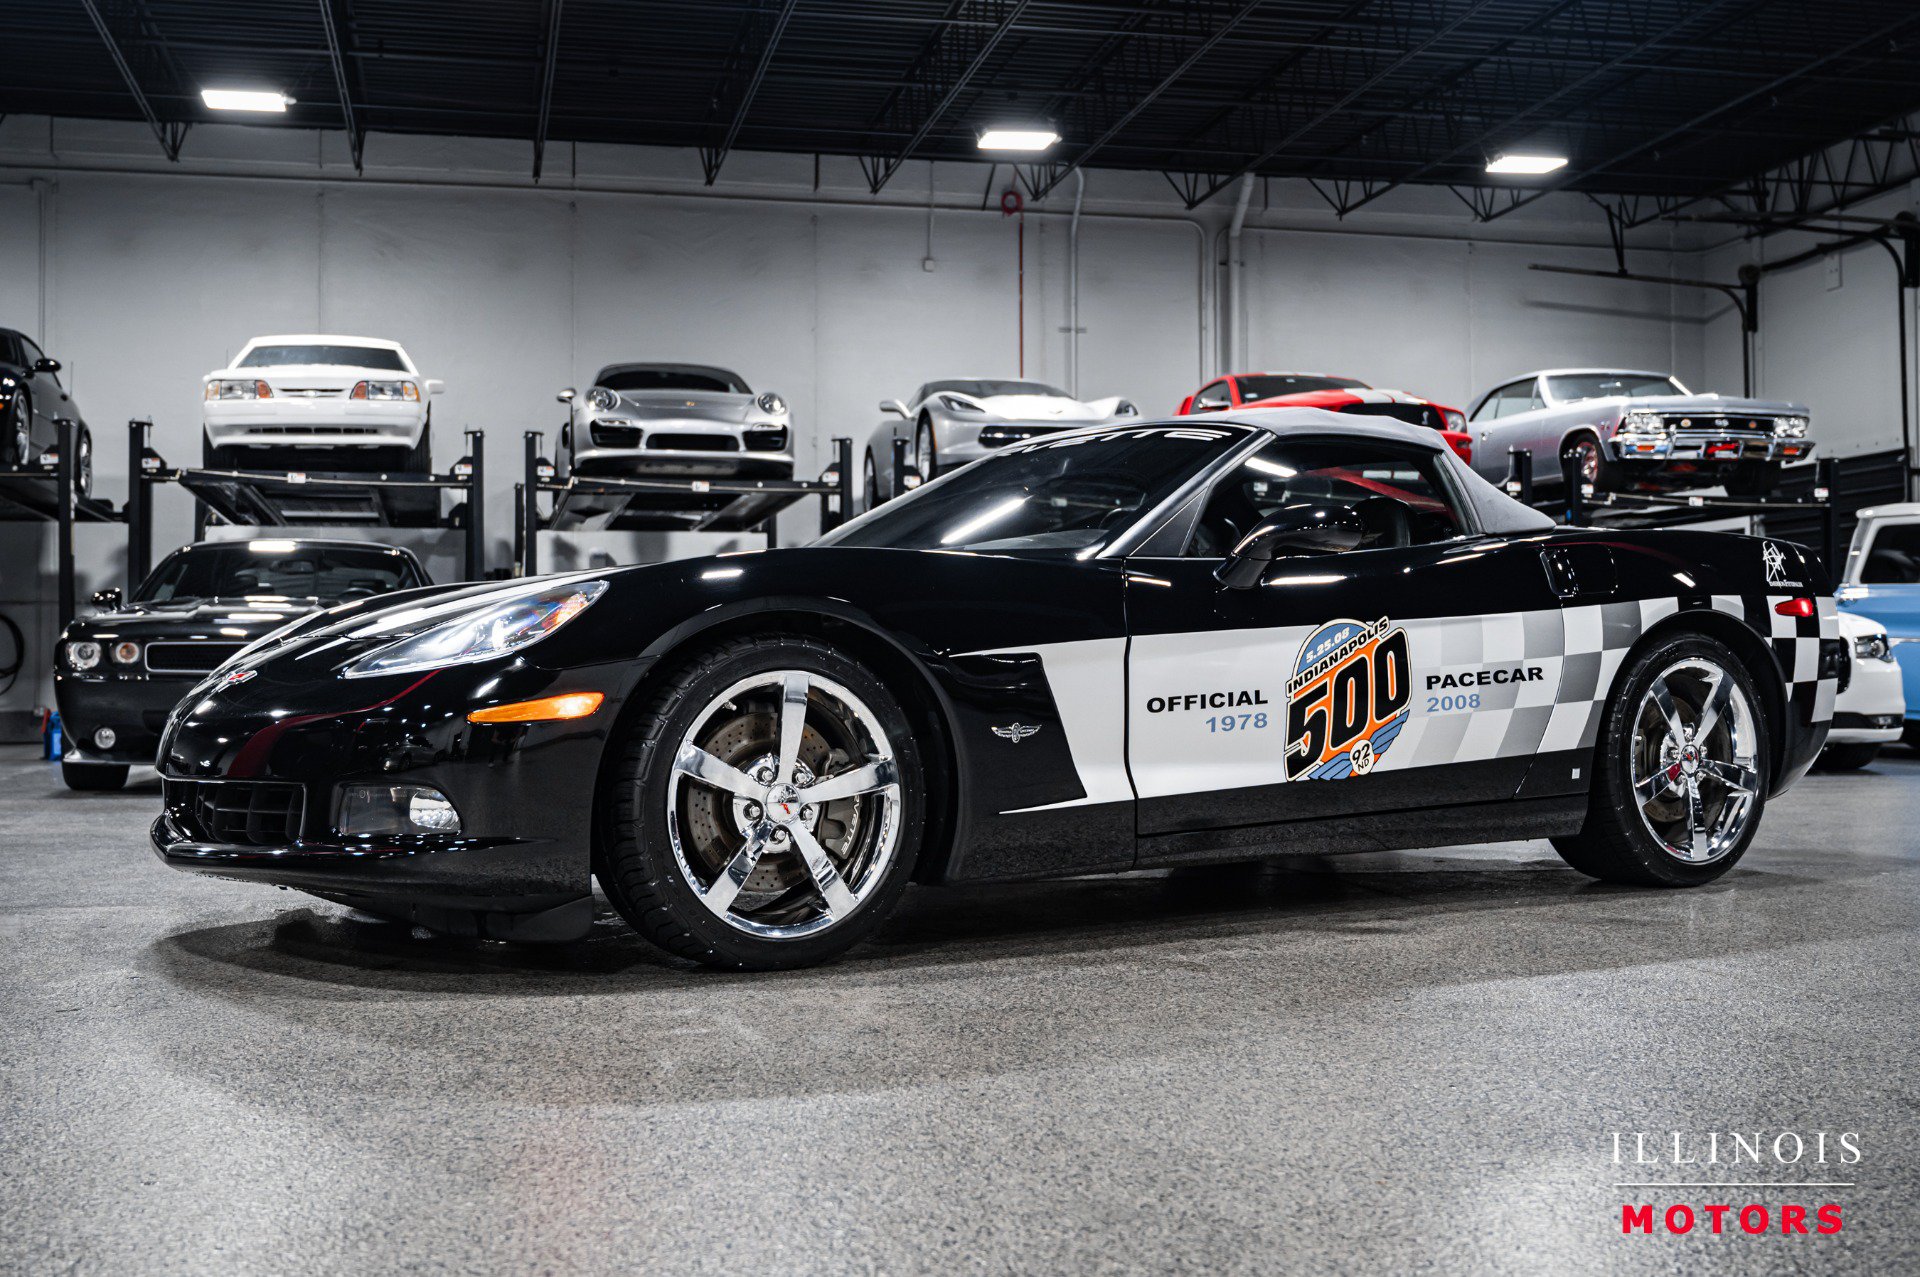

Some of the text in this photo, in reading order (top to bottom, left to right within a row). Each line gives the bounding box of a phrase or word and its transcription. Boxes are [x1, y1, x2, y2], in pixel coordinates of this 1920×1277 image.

[1287, 617, 1389, 694] INDIANAPOLIS
[1306, 626, 1351, 664] 5.25.08
[1426, 666, 1544, 691] PACECAR
[1146, 689, 1269, 714] OFFICIAL
[1285, 627, 1411, 780] 500
[1426, 693, 1481, 713] 2008
[1205, 712, 1268, 733] 1978
[1352, 742, 1371, 765] 92
[1357, 758, 1371, 772] ND
